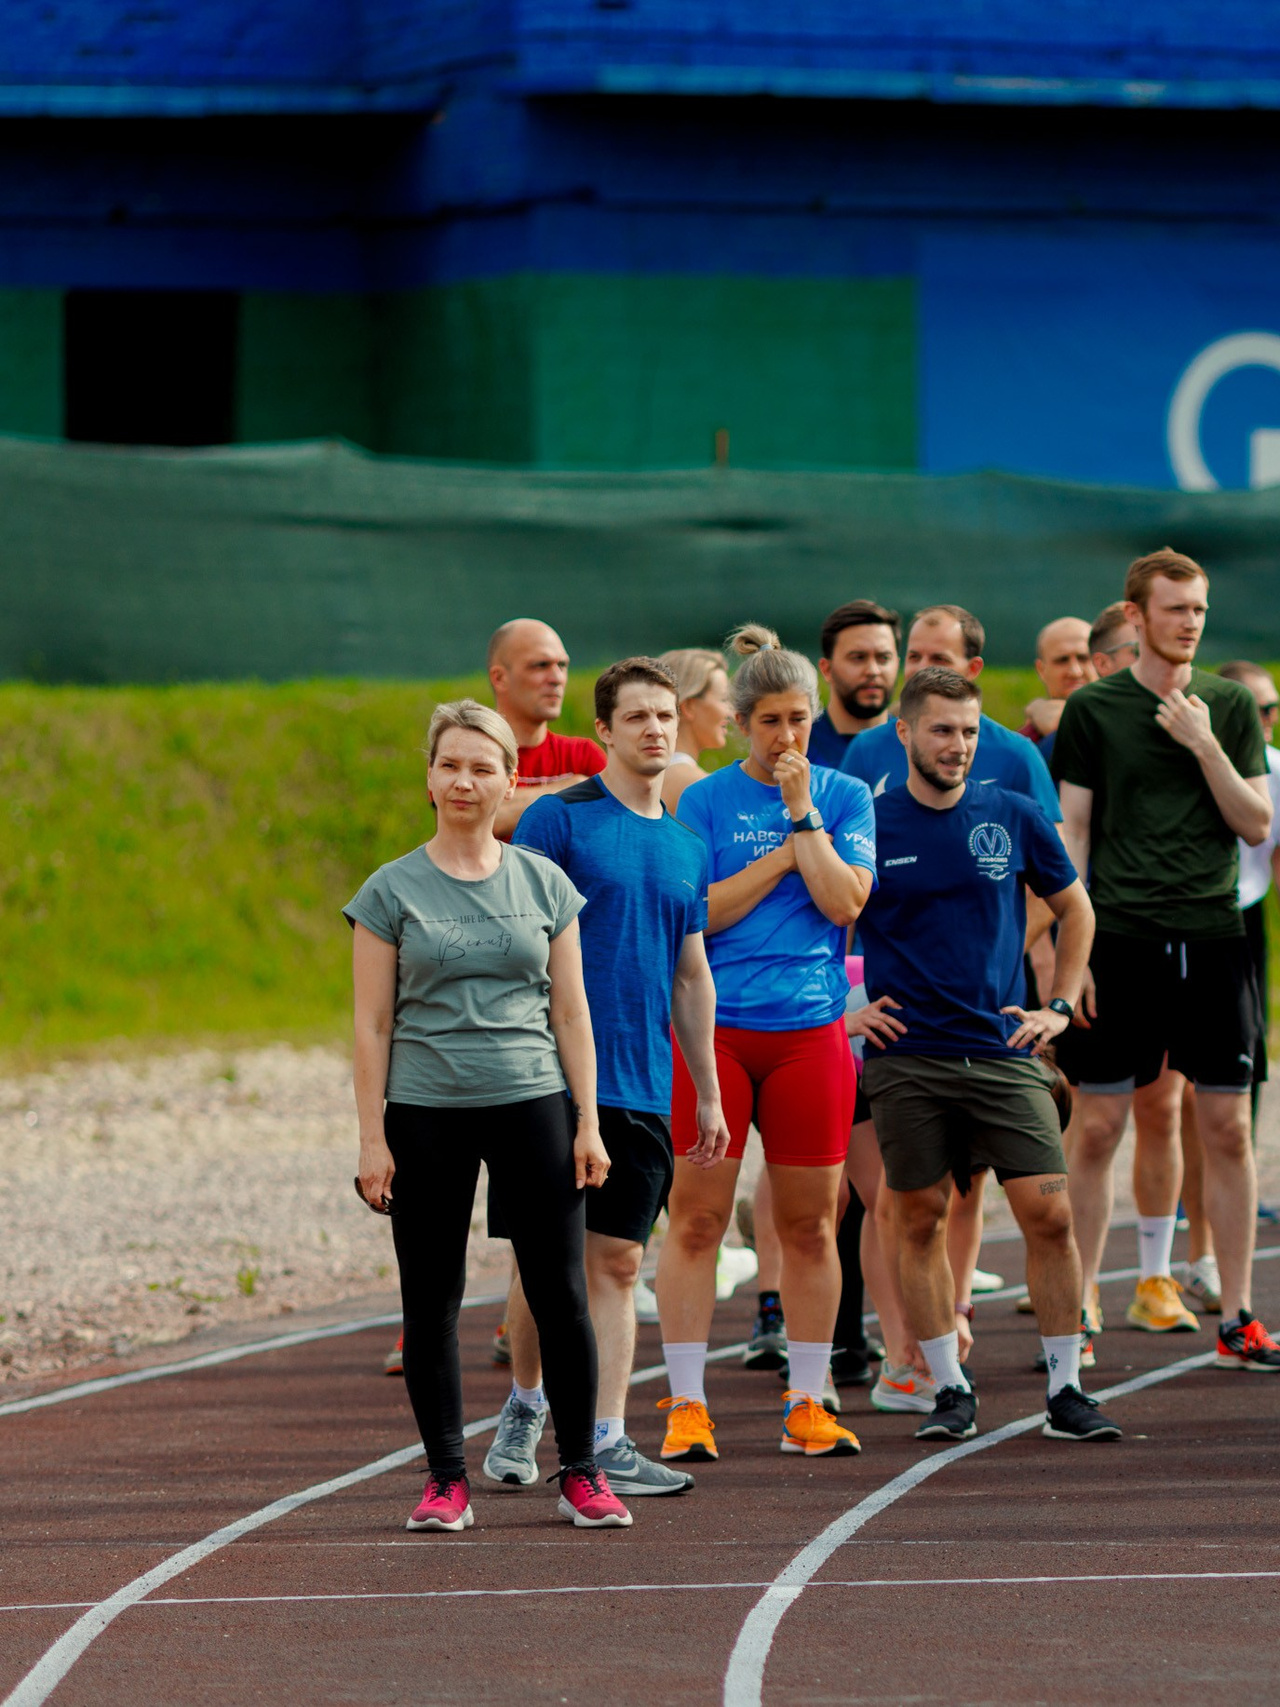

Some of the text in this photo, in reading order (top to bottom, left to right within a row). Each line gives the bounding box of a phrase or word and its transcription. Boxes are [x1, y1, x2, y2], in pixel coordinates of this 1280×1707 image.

[753, 845, 781, 857] ИГ
[460, 914, 486, 924] LIFE IS
[429, 924, 512, 967] Beauty
